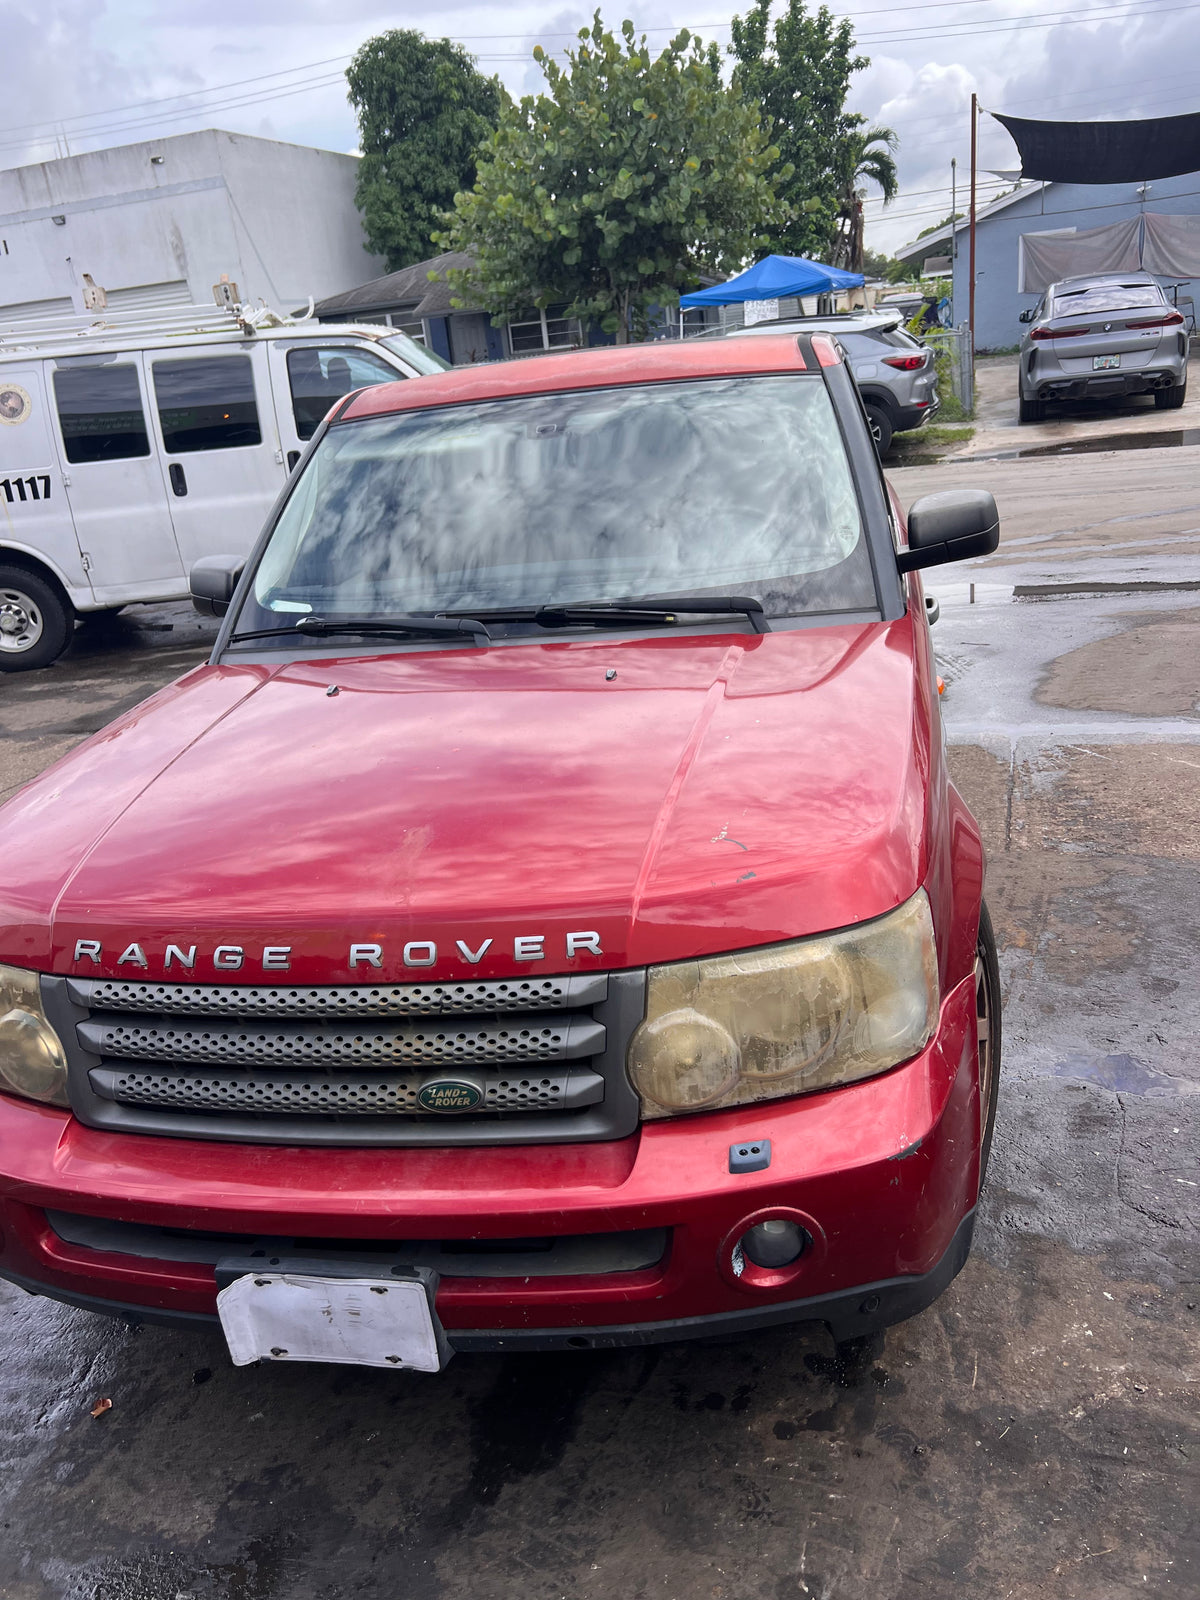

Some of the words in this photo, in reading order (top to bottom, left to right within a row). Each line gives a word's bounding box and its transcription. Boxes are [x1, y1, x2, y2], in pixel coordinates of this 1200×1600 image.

[73, 939, 292, 970] RANGE
[349, 930, 604, 968] ROVER
[430, 1088, 461, 1098] LAND
[434, 1097, 471, 1107] ROVER
